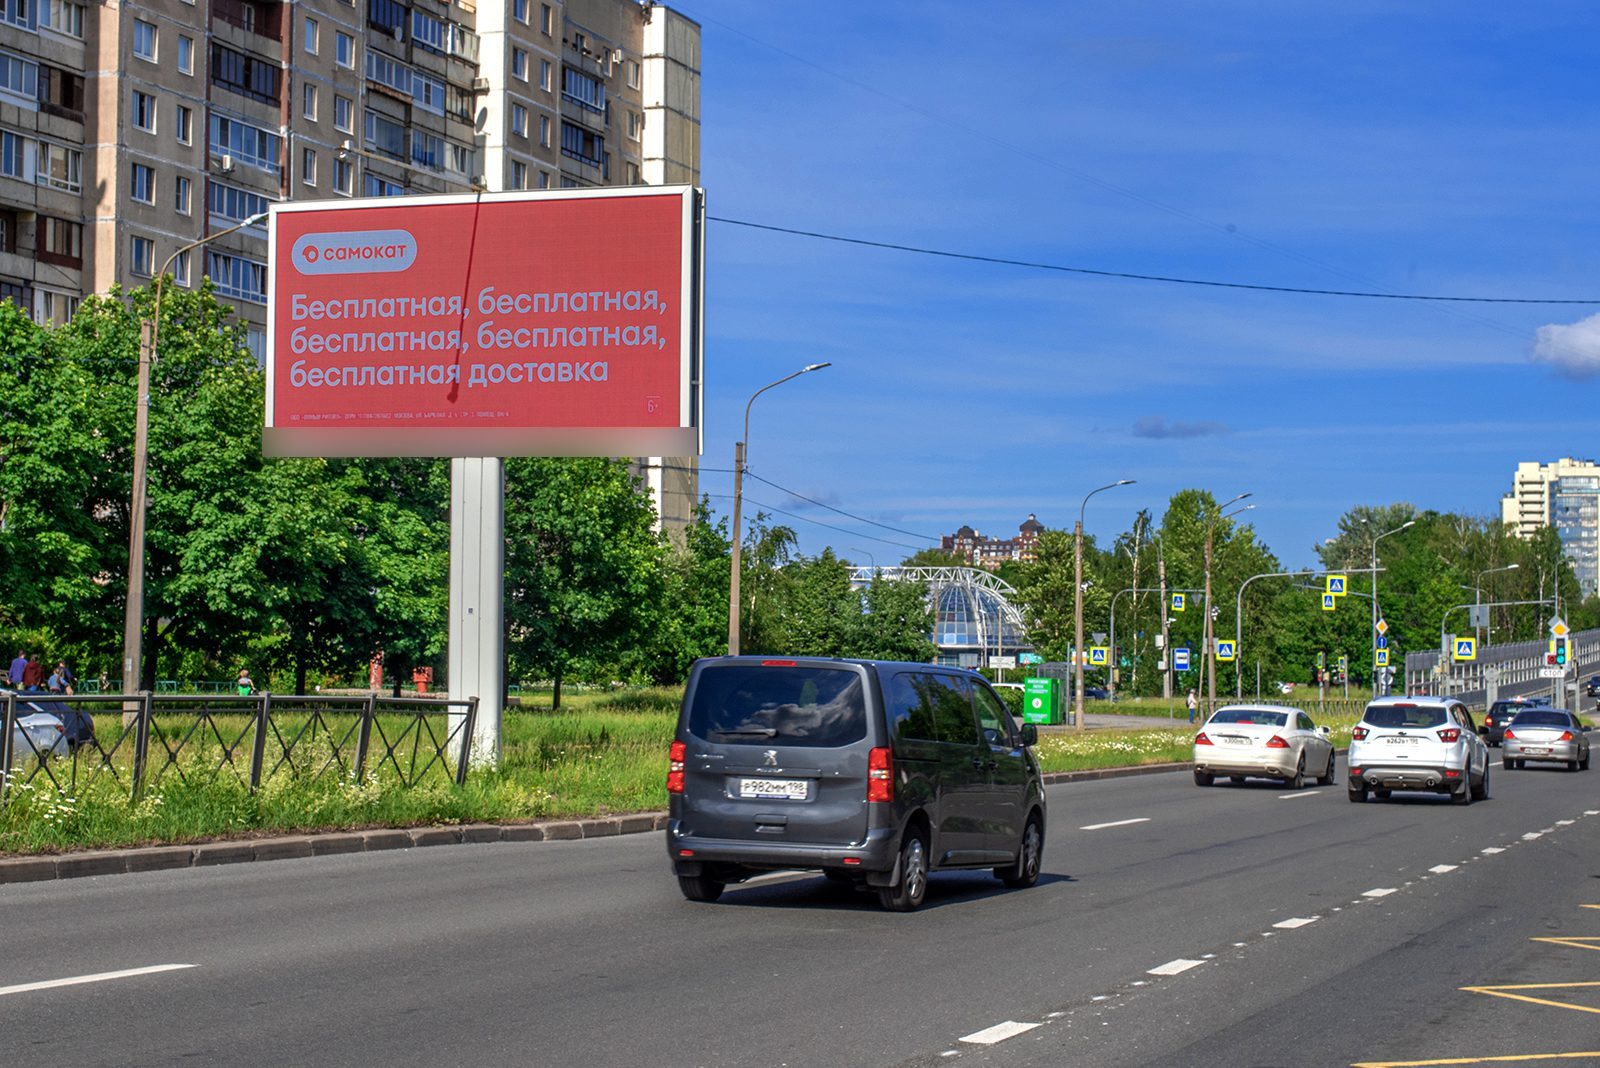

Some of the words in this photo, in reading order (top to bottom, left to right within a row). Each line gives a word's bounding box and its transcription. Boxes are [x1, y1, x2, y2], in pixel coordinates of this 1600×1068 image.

[323, 245, 407, 261] самокат
[292, 294, 470, 320] Бесплатная,
[477, 286, 667, 315] бесплатная,
[290, 326, 469, 354] бесплатная,
[477, 320, 666, 350] бесплатная,
[290, 360, 461, 387] бесплатная
[468, 361, 608, 388] доставка
